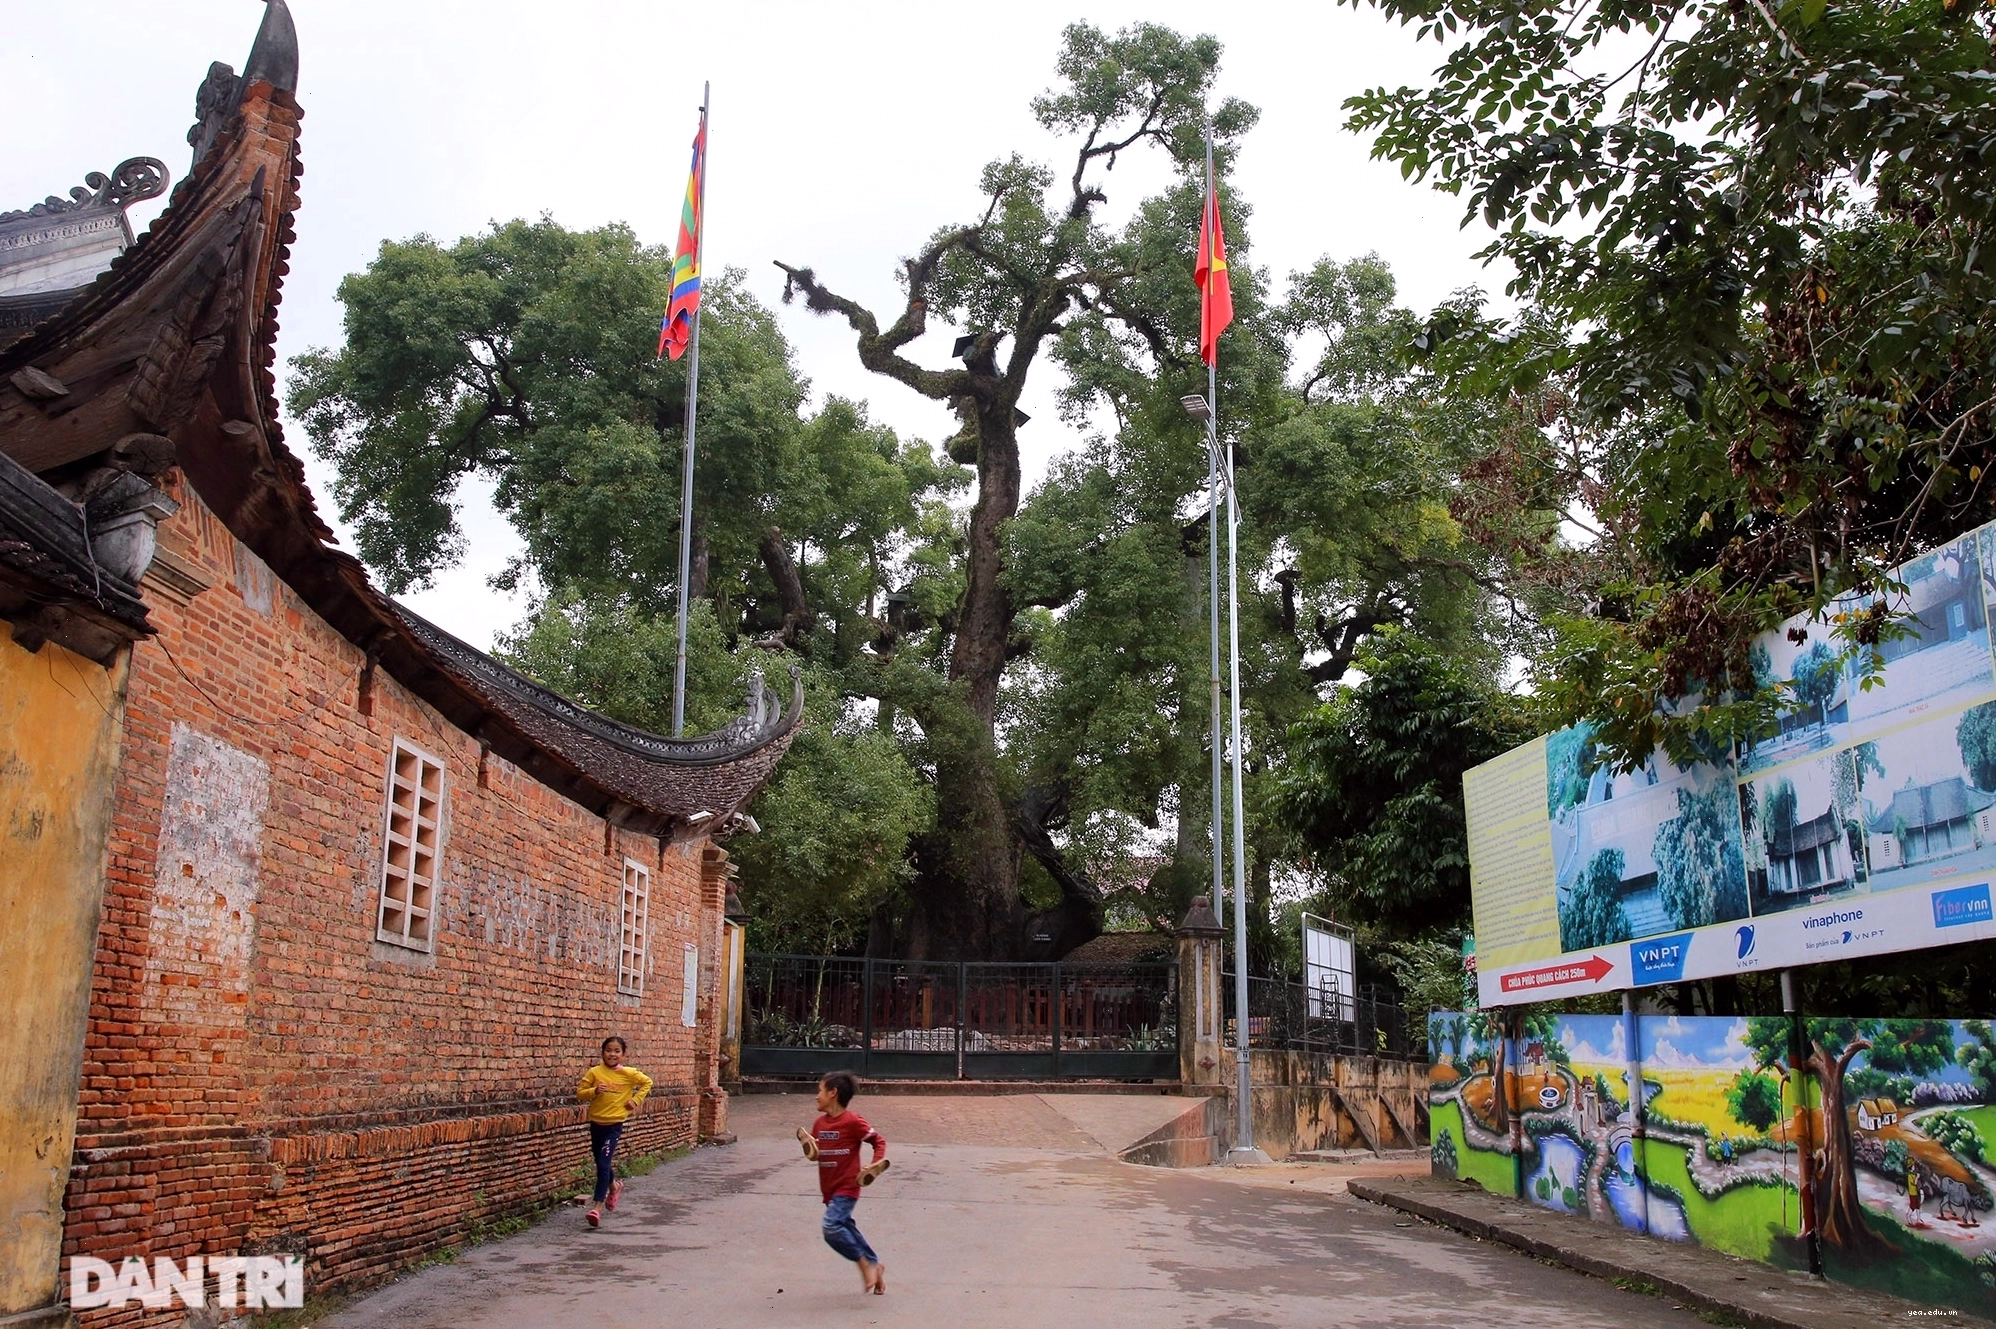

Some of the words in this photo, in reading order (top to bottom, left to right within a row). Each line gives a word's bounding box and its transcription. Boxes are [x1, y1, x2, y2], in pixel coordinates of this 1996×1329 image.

[1802, 909, 1863, 929] vinaphone
[1854, 929, 1885, 941] VNPT
[1639, 945, 1680, 963] VNPT
[1736, 959, 1759, 969] VNPT
[1535, 971, 1555, 985] QUANG
[1554, 968, 1570, 982] CÁCH
[1570, 967, 1586, 979] 250m
